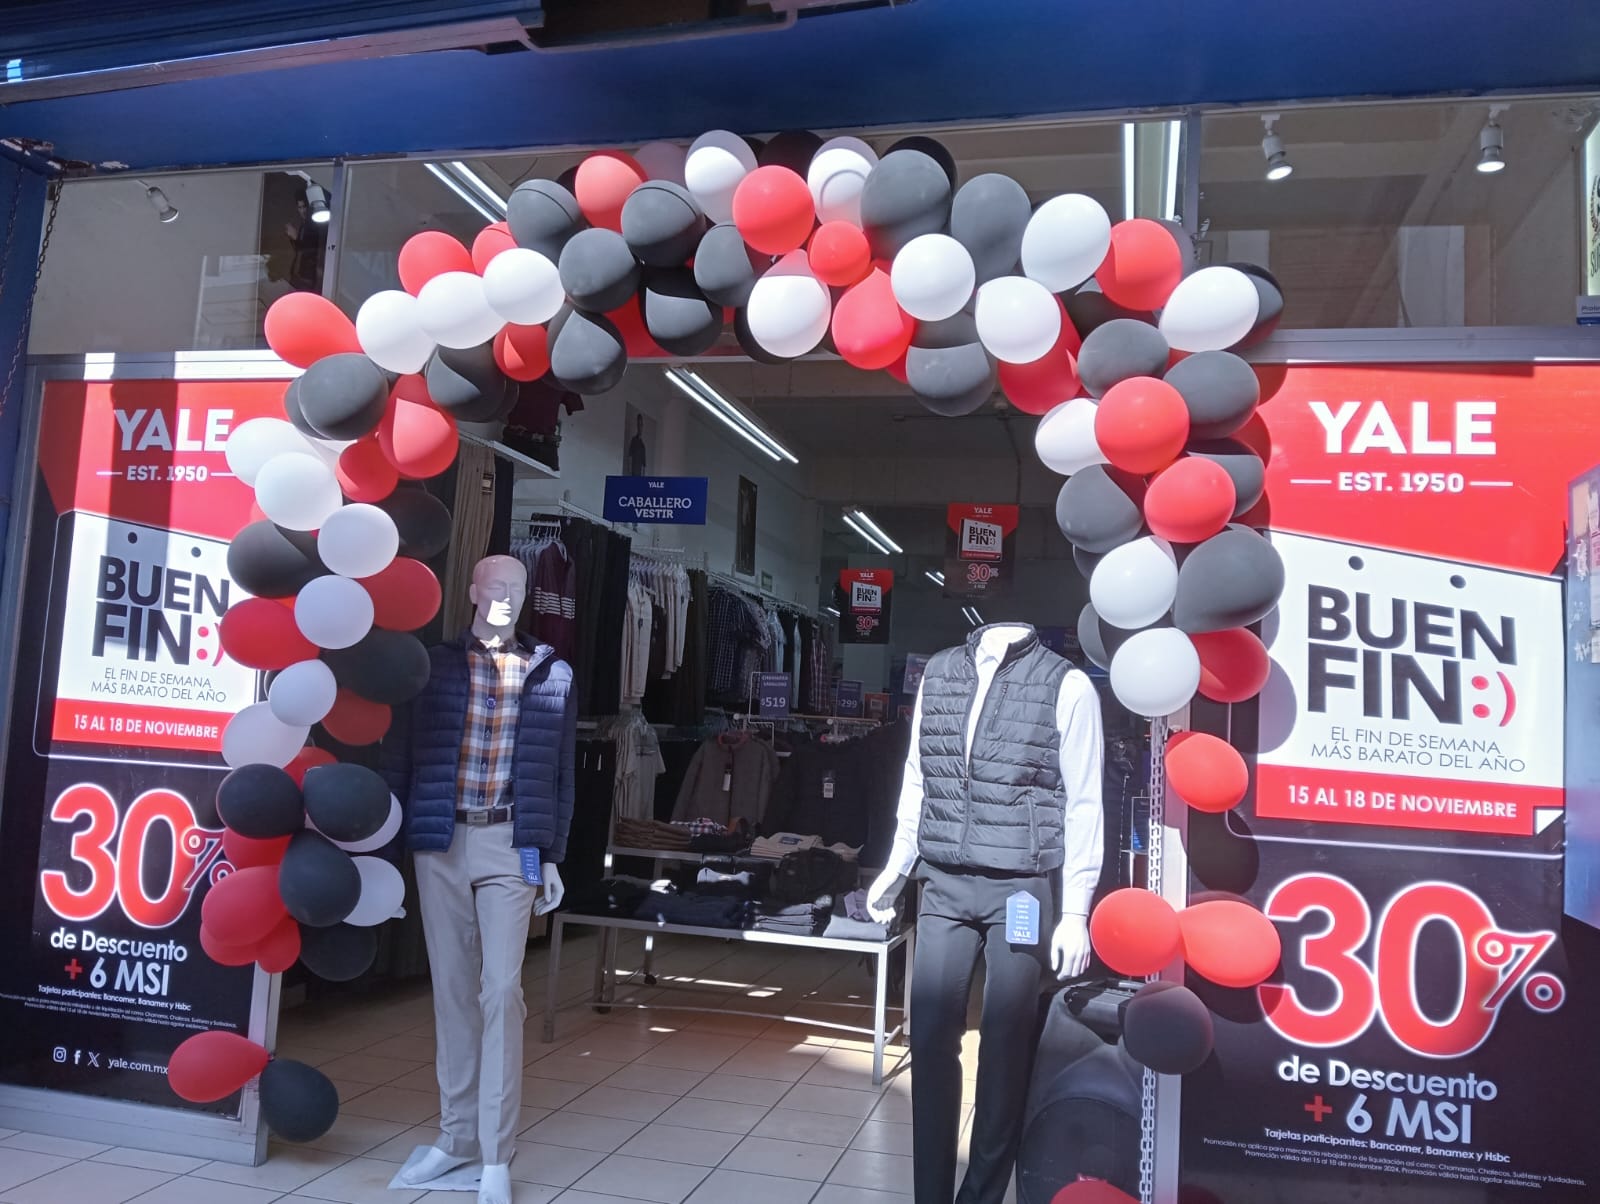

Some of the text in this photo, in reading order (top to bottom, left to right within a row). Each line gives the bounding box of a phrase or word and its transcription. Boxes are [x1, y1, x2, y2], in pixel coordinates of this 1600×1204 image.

[114, 408, 234, 451] YALE
[1308, 401, 1496, 454] YALE
[127, 465, 207, 481] EST. 1950
[1338, 472, 1464, 492] EST. 1950
[619, 496, 691, 508] CABALLERO
[635, 509, 673, 518] VESTIR
[969, 526, 996, 537] BUEN
[96, 555, 229, 617] BUEN
[857, 588, 877, 596] BUEN
[1308, 584, 1517, 665] BUEN
[91, 679, 226, 702] MÁS BARATO DEL AÑO
[105, 668, 212, 688] EL FIN DE SEMANA
[74, 714, 218, 738] 15 AL 18 DE NOVIEMBRE
[1331, 726, 1500, 754] EL FIN DE SEMANA
[1311, 741, 1525, 772] MÁS BARATO DEL AÑO
[1288, 785, 1517, 818] 15 AL 18 DE NOVIEMBRE
[41, 782, 236, 928] 30%
[51, 927, 188, 962] de Descuento
[1013, 930, 1031, 938] YALE
[90, 957, 107, 988] 6
[114, 958, 169, 996] MSI
[1258, 872, 1566, 1059] 30%
[38, 984, 61, 994] Tarjetas
[62, 988, 102, 1000] participantes:
[104, 993, 137, 1004] Bancomer,
[138, 998, 168, 1008] Banamex
[169, 1002, 174, 1010] y
[175, 1002, 191, 1011] Hsbc
[108, 1057, 168, 1074] yale.com.mx
[1278, 1056, 1497, 1100] de Descuento
[1347, 1094, 1372, 1133] 6
[1386, 1097, 1471, 1144] MSI
[1264, 1128, 1510, 1163] Tarjetas participantes: Bancomer, Banamex y Hsbc
